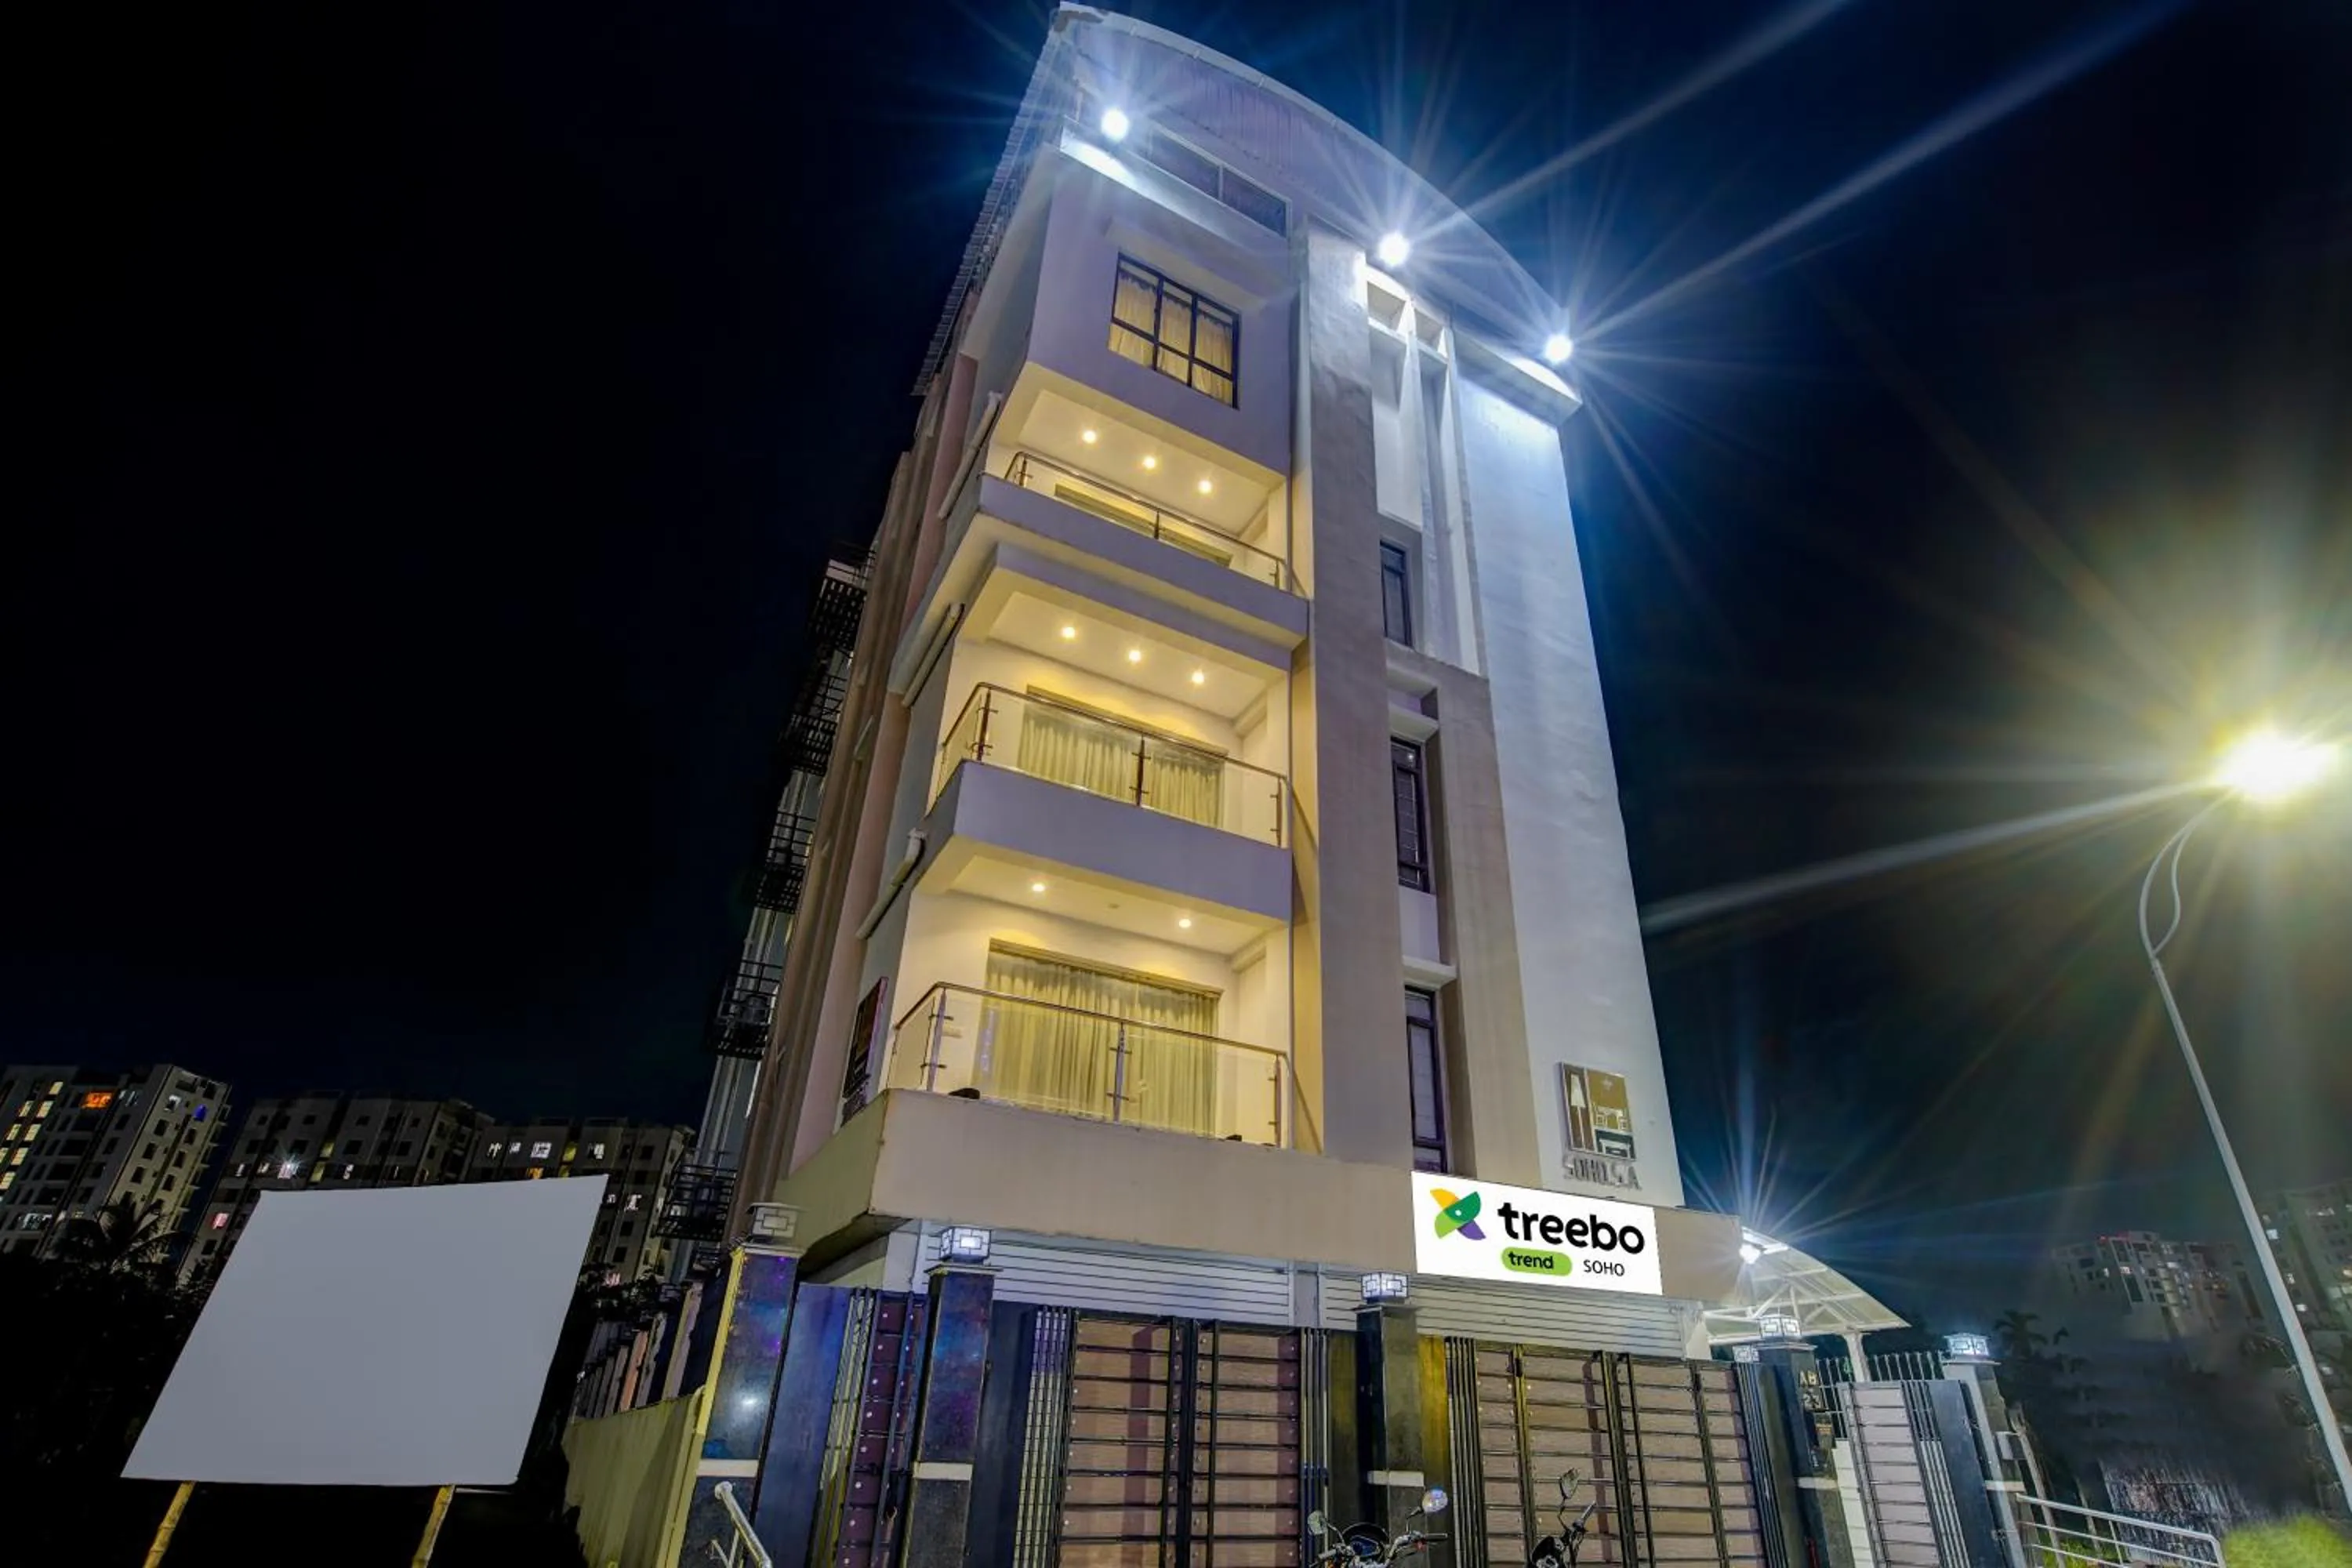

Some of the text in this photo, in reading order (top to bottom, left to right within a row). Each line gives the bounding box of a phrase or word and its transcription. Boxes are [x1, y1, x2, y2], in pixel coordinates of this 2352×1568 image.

[1497, 1202, 1645, 1254] treebo
[1508, 1251, 1555, 1270] trend
[1583, 1259, 1625, 1277] SOHO
